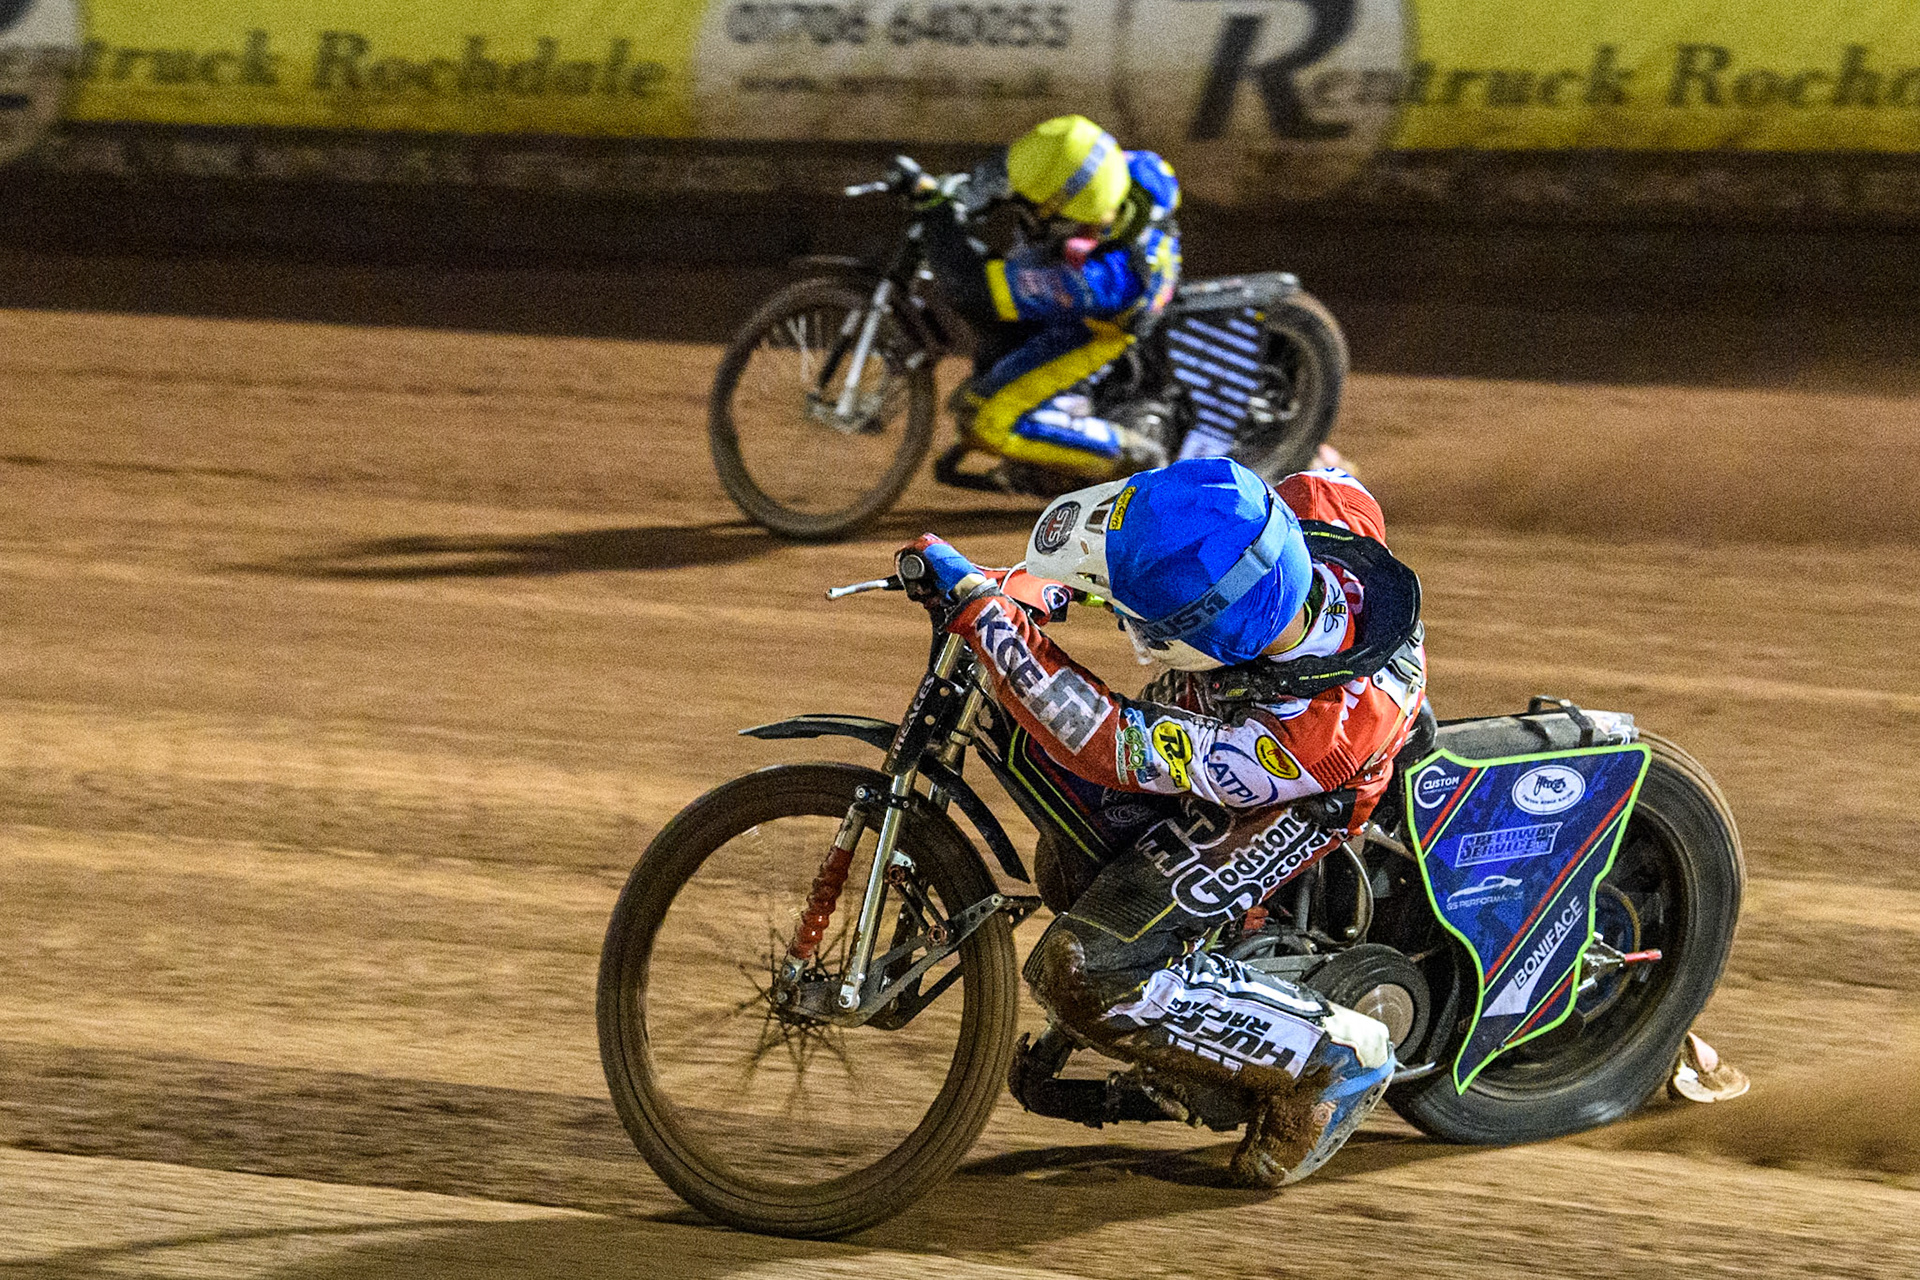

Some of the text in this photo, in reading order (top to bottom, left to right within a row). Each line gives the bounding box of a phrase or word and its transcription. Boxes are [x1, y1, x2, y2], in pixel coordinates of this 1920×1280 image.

[0, 28, 279, 87] entruck
[313, 29, 670, 98] Rochdale
[1207, 761, 1262, 804] ATPI
[1423, 775, 1460, 791] CUSTOM
[1466, 823, 1559, 846] SPEEDWAY
[1513, 895, 1584, 989] BONIFACE
